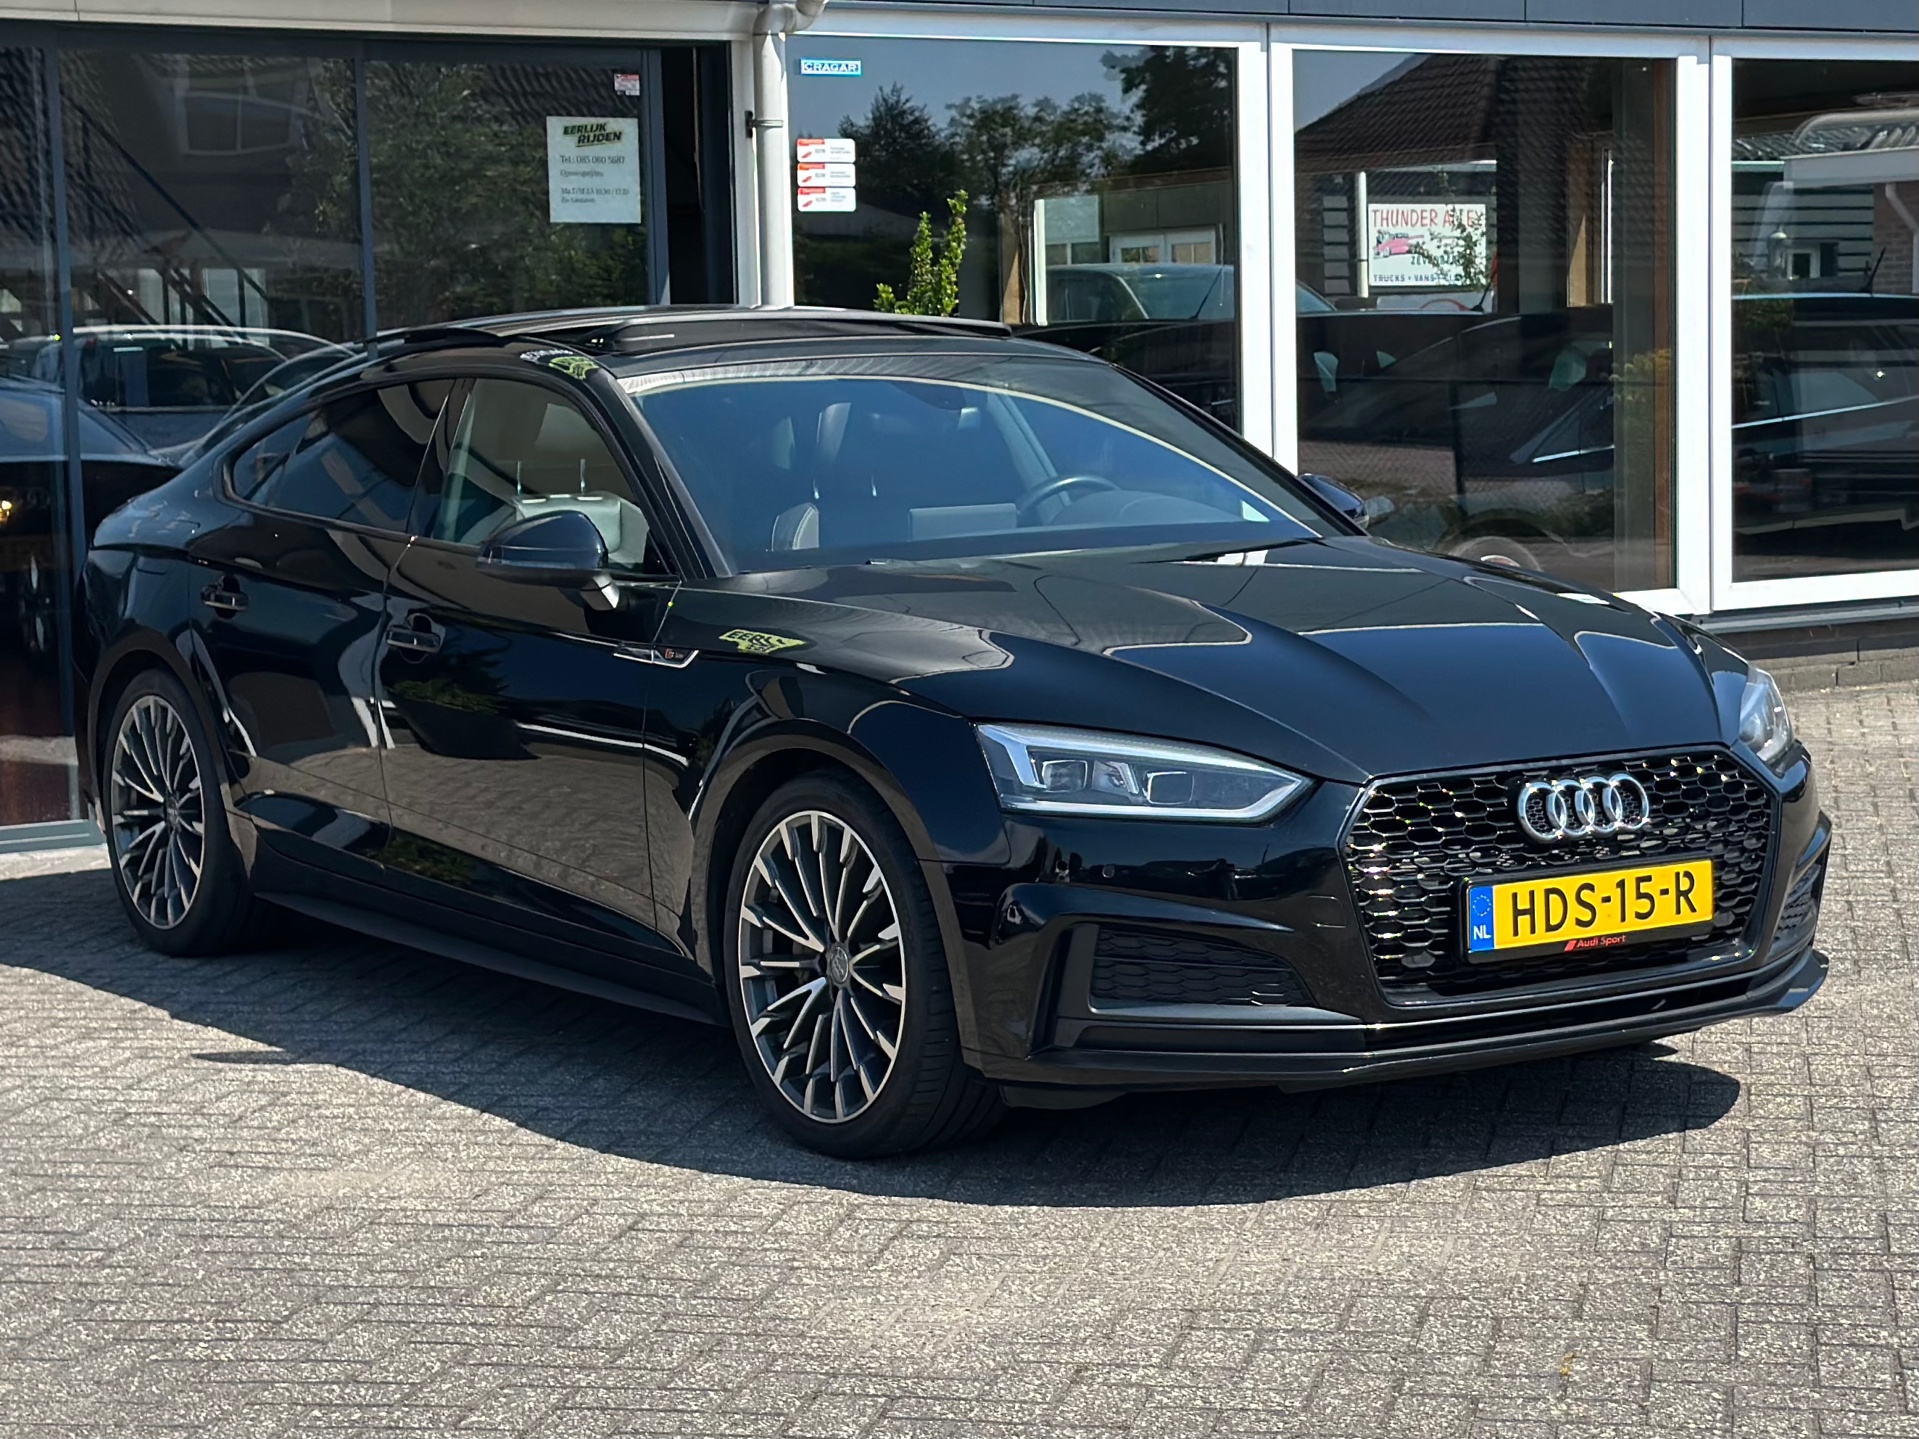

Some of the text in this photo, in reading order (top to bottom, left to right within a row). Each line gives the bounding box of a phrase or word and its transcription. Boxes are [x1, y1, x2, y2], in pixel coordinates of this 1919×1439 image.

[803, 62, 859, 72] CRAGAR
[563, 123, 607, 135] EERLIJK
[577, 131, 622, 144] RIJDEN
[1372, 208, 1438, 228] THUNDER
[1373, 274, 1405, 282] TRUCKS
[1414, 274, 1435, 282] VANS
[1511, 870, 1698, 938] HDS-15-R
[1473, 924, 1491, 940] NL
[1576, 935, 1627, 948] Audi Sport
